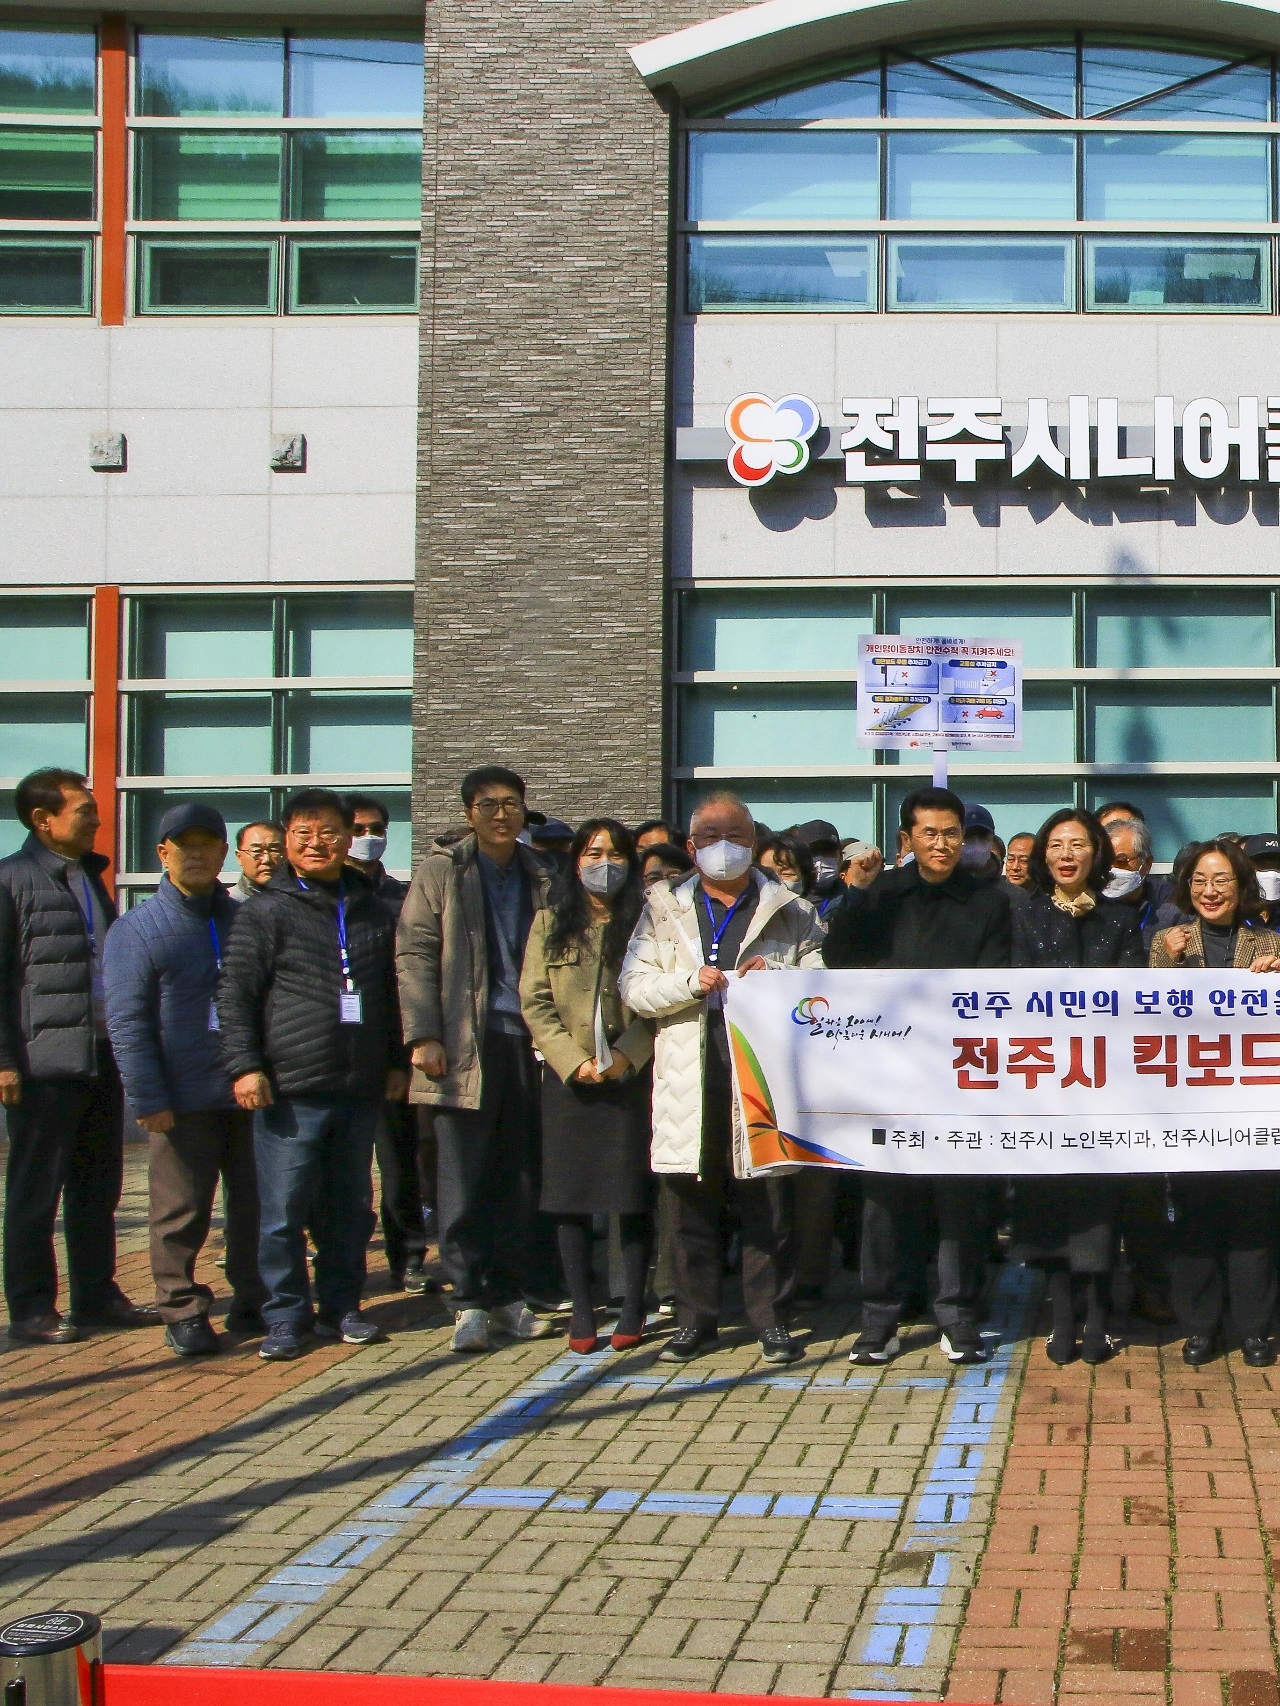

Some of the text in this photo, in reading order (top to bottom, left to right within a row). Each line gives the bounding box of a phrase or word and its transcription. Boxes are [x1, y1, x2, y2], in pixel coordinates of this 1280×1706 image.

[951, 991, 1012, 1019] 전주
[1026, 990, 1119, 1018] 시민의
[1134, 989, 1194, 1018] 보행
[952, 1035, 1107, 1090] 전주시
[890, 1130, 925, 1150] 주최
[946, 1130, 983, 1150] 주관
[1000, 1130, 1053, 1150] 전주시
[1061, 1129, 1156, 1149] 노인복지과,
